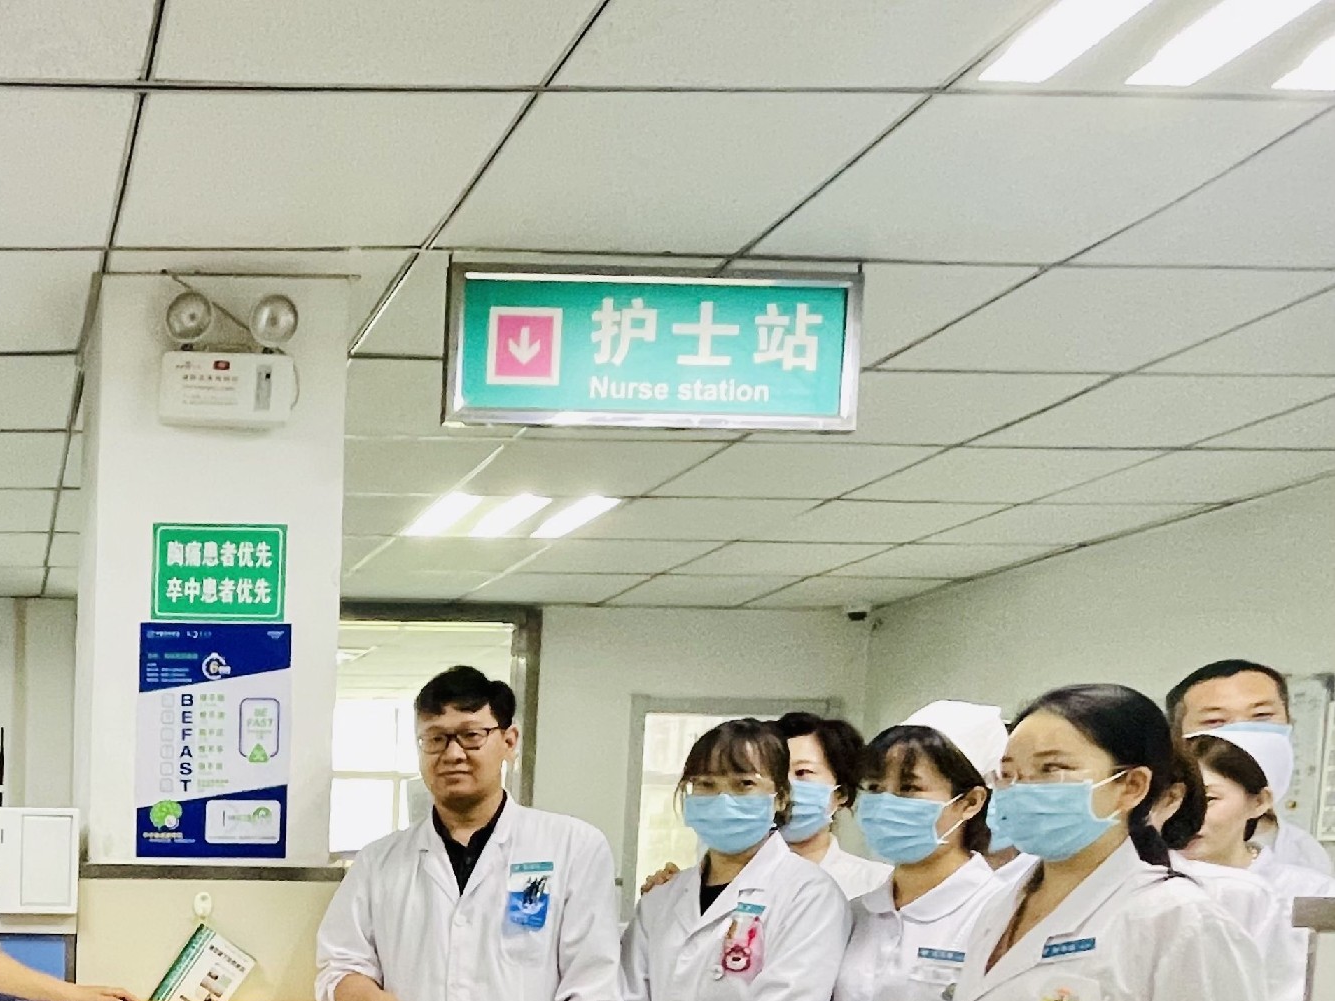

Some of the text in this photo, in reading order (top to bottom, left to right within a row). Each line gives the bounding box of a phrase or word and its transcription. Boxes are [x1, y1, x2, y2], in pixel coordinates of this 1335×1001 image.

[590, 297, 823, 371] 护士站
[589, 376, 770, 403] Nurse station
[166, 540, 273, 568] 胸痛患者优先
[166, 576, 272, 604] 卒中患者优先
